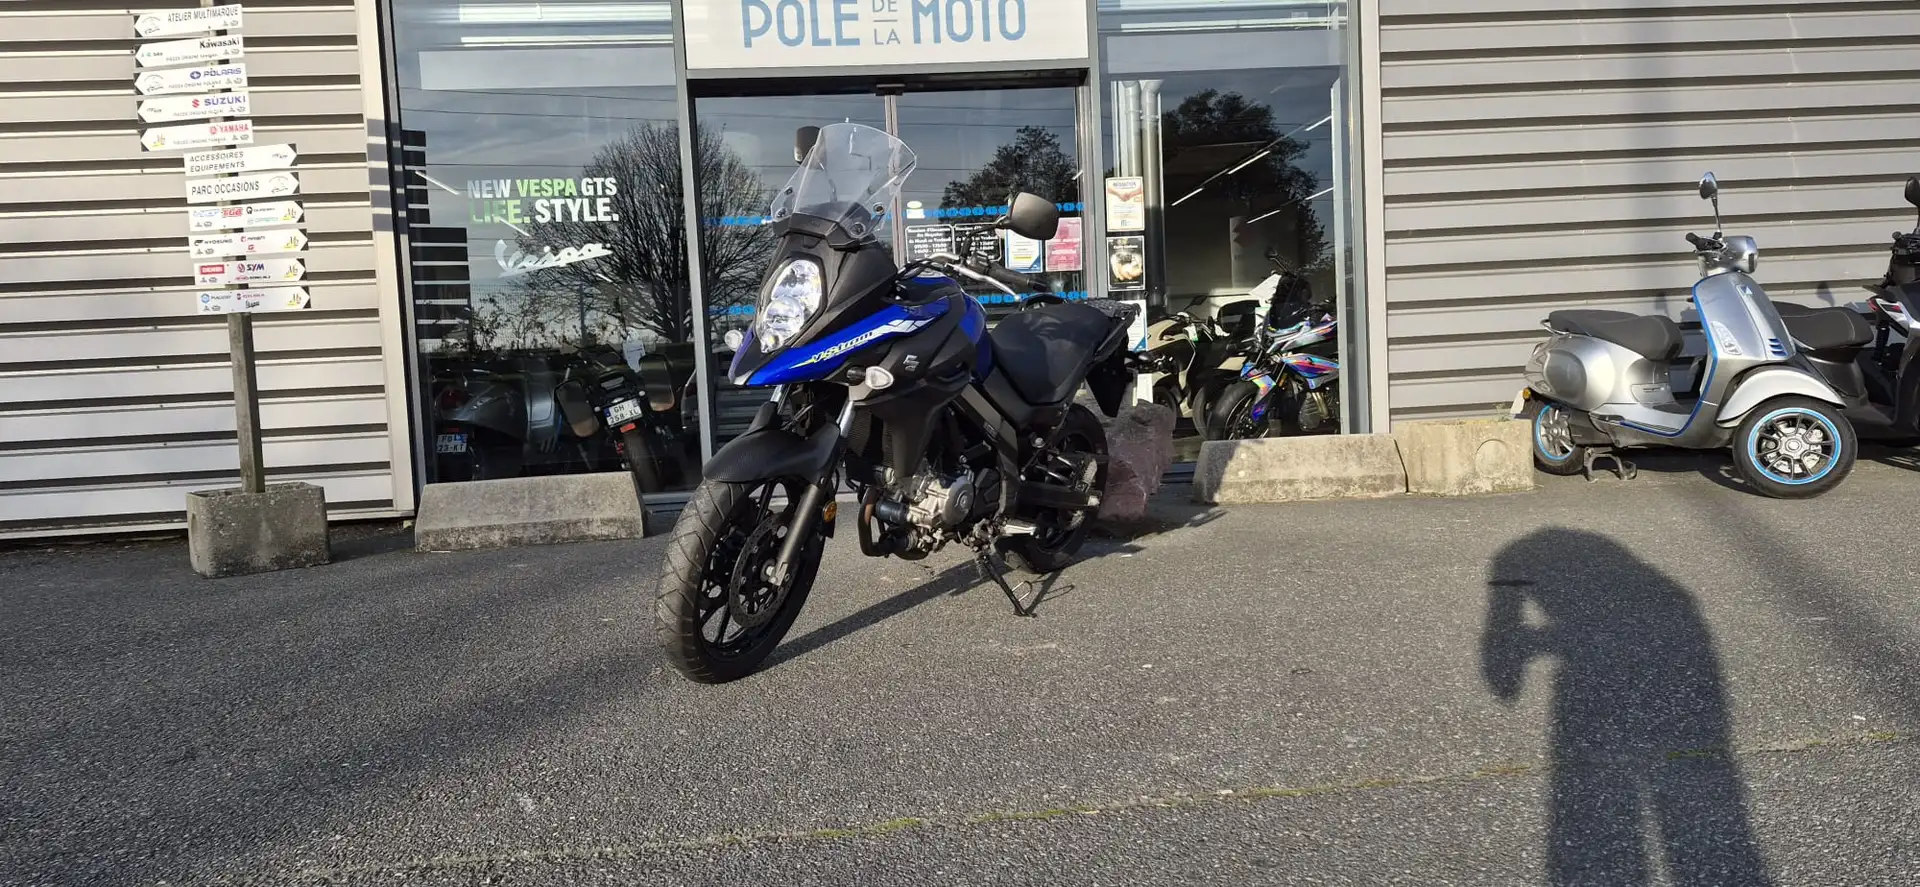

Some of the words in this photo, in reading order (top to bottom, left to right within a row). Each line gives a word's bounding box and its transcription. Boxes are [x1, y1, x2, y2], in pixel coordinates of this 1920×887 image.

[872, 0, 898, 13] DE
[168, 11, 192, 23] ATELIER
[193, 6, 239, 19] MULTIMARQUE
[911, 0, 1026, 44] MOTO
[199, 37, 240, 49] Kawasaki
[873, 28, 901, 45] LA
[203, 67, 242, 78] POLARIS
[204, 95, 246, 107] SUZUKI
[220, 123, 249, 133] YAMAHA
[189, 151, 244, 162] ACCESSOIRES
[190, 161, 245, 173] EQUIPEMENTS
[191, 184, 213, 196] PARC
[214, 181, 260, 195] OCCASIONS
[467, 179, 511, 199] NEW
[516, 178, 577, 198] VESPA
[581, 177, 618, 197] GTS
[469, 199, 531, 225] LIFE.
[535, 197, 619, 223] STYLE.
[495, 239, 614, 278] Vespa
[246, 262, 264, 272] SYM
